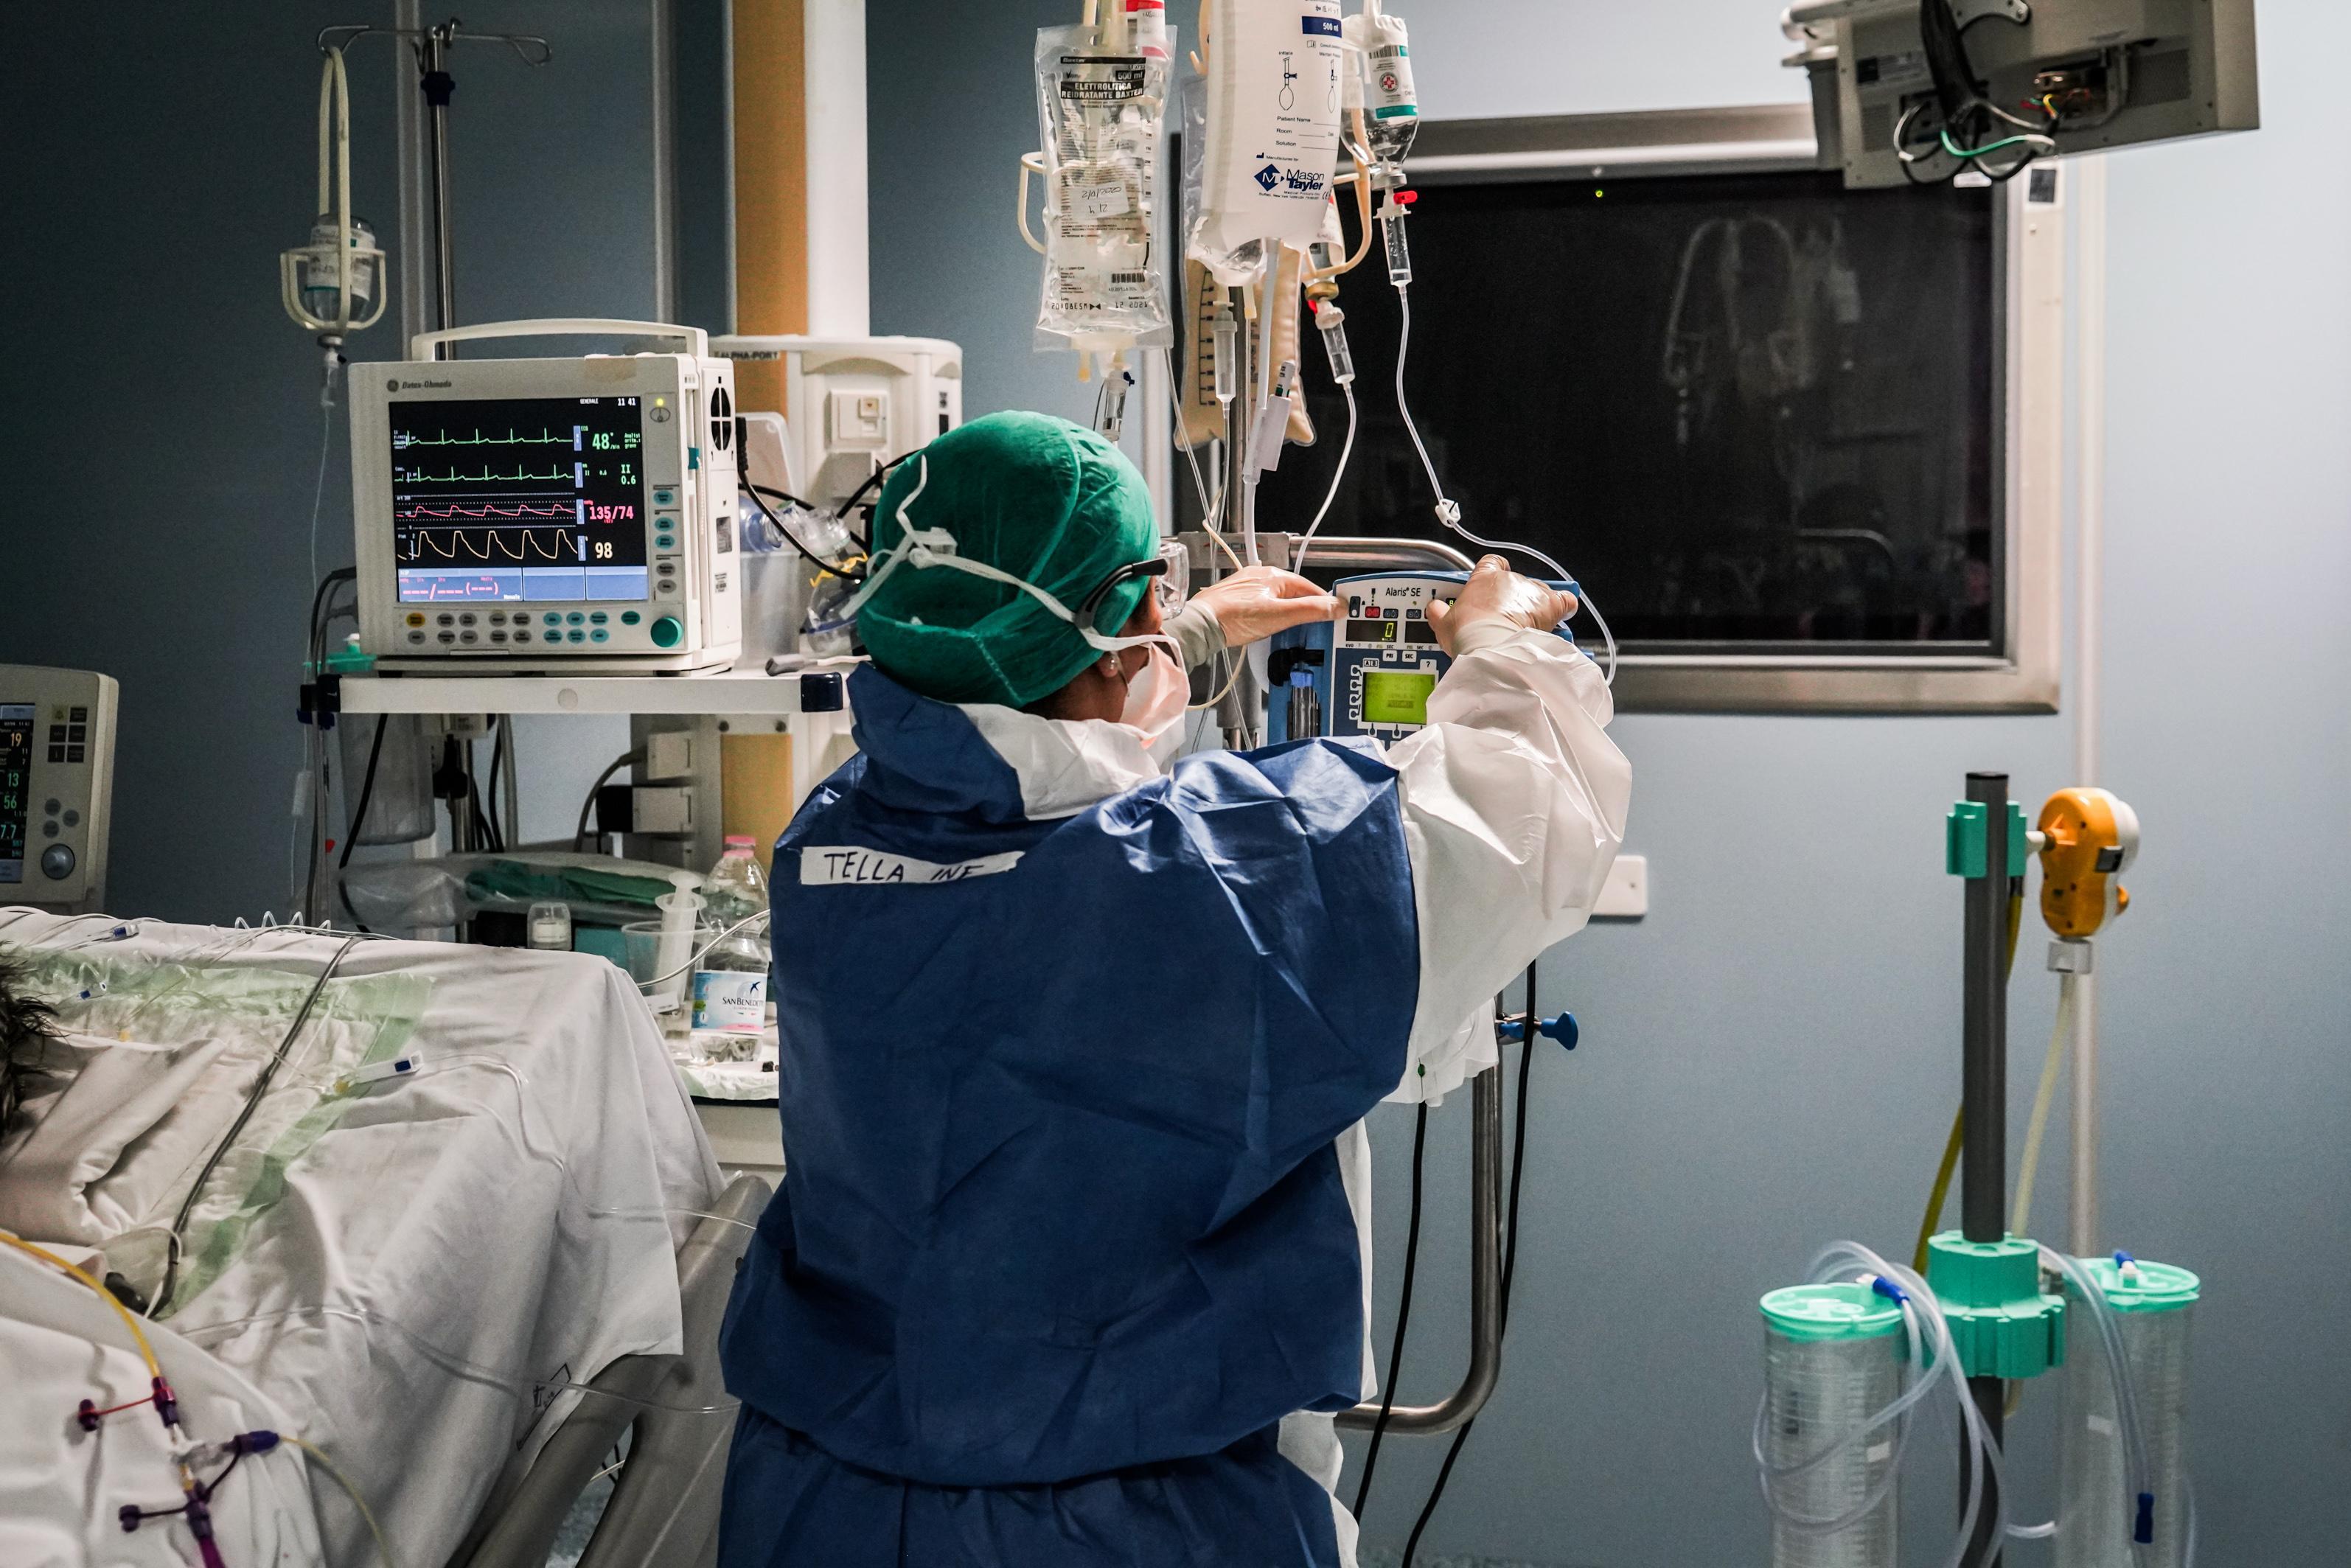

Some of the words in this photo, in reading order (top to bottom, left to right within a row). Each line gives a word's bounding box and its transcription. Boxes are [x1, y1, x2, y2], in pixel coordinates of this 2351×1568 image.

[1323, 22, 1333, 31] 500
[1118, 72, 1132, 80] 500
[1133, 71, 1143, 80] ml
[1061, 90, 1113, 99] REIDRATANTE
[1115, 88, 1143, 99] BAXTER
[1075, 82, 1132, 91] ELETTROLITICA
[1286, 168, 1325, 181] Mason
[1288, 178, 1324, 192] Tayler
[592, 433, 610, 450] 48
[621, 464, 631, 474] II
[621, 475, 636, 485] 0.6
[590, 506, 634, 520] 135/74
[595, 541, 613, 559] 98
[1410, 588, 1421, 597] SE
[1385, 622, 1395, 638] 0
[10, 732, 22, 748] 19
[7, 772, 19, 787] 13
[4, 795, 18, 810] 56
[823, 851, 904, 882] TELLA
